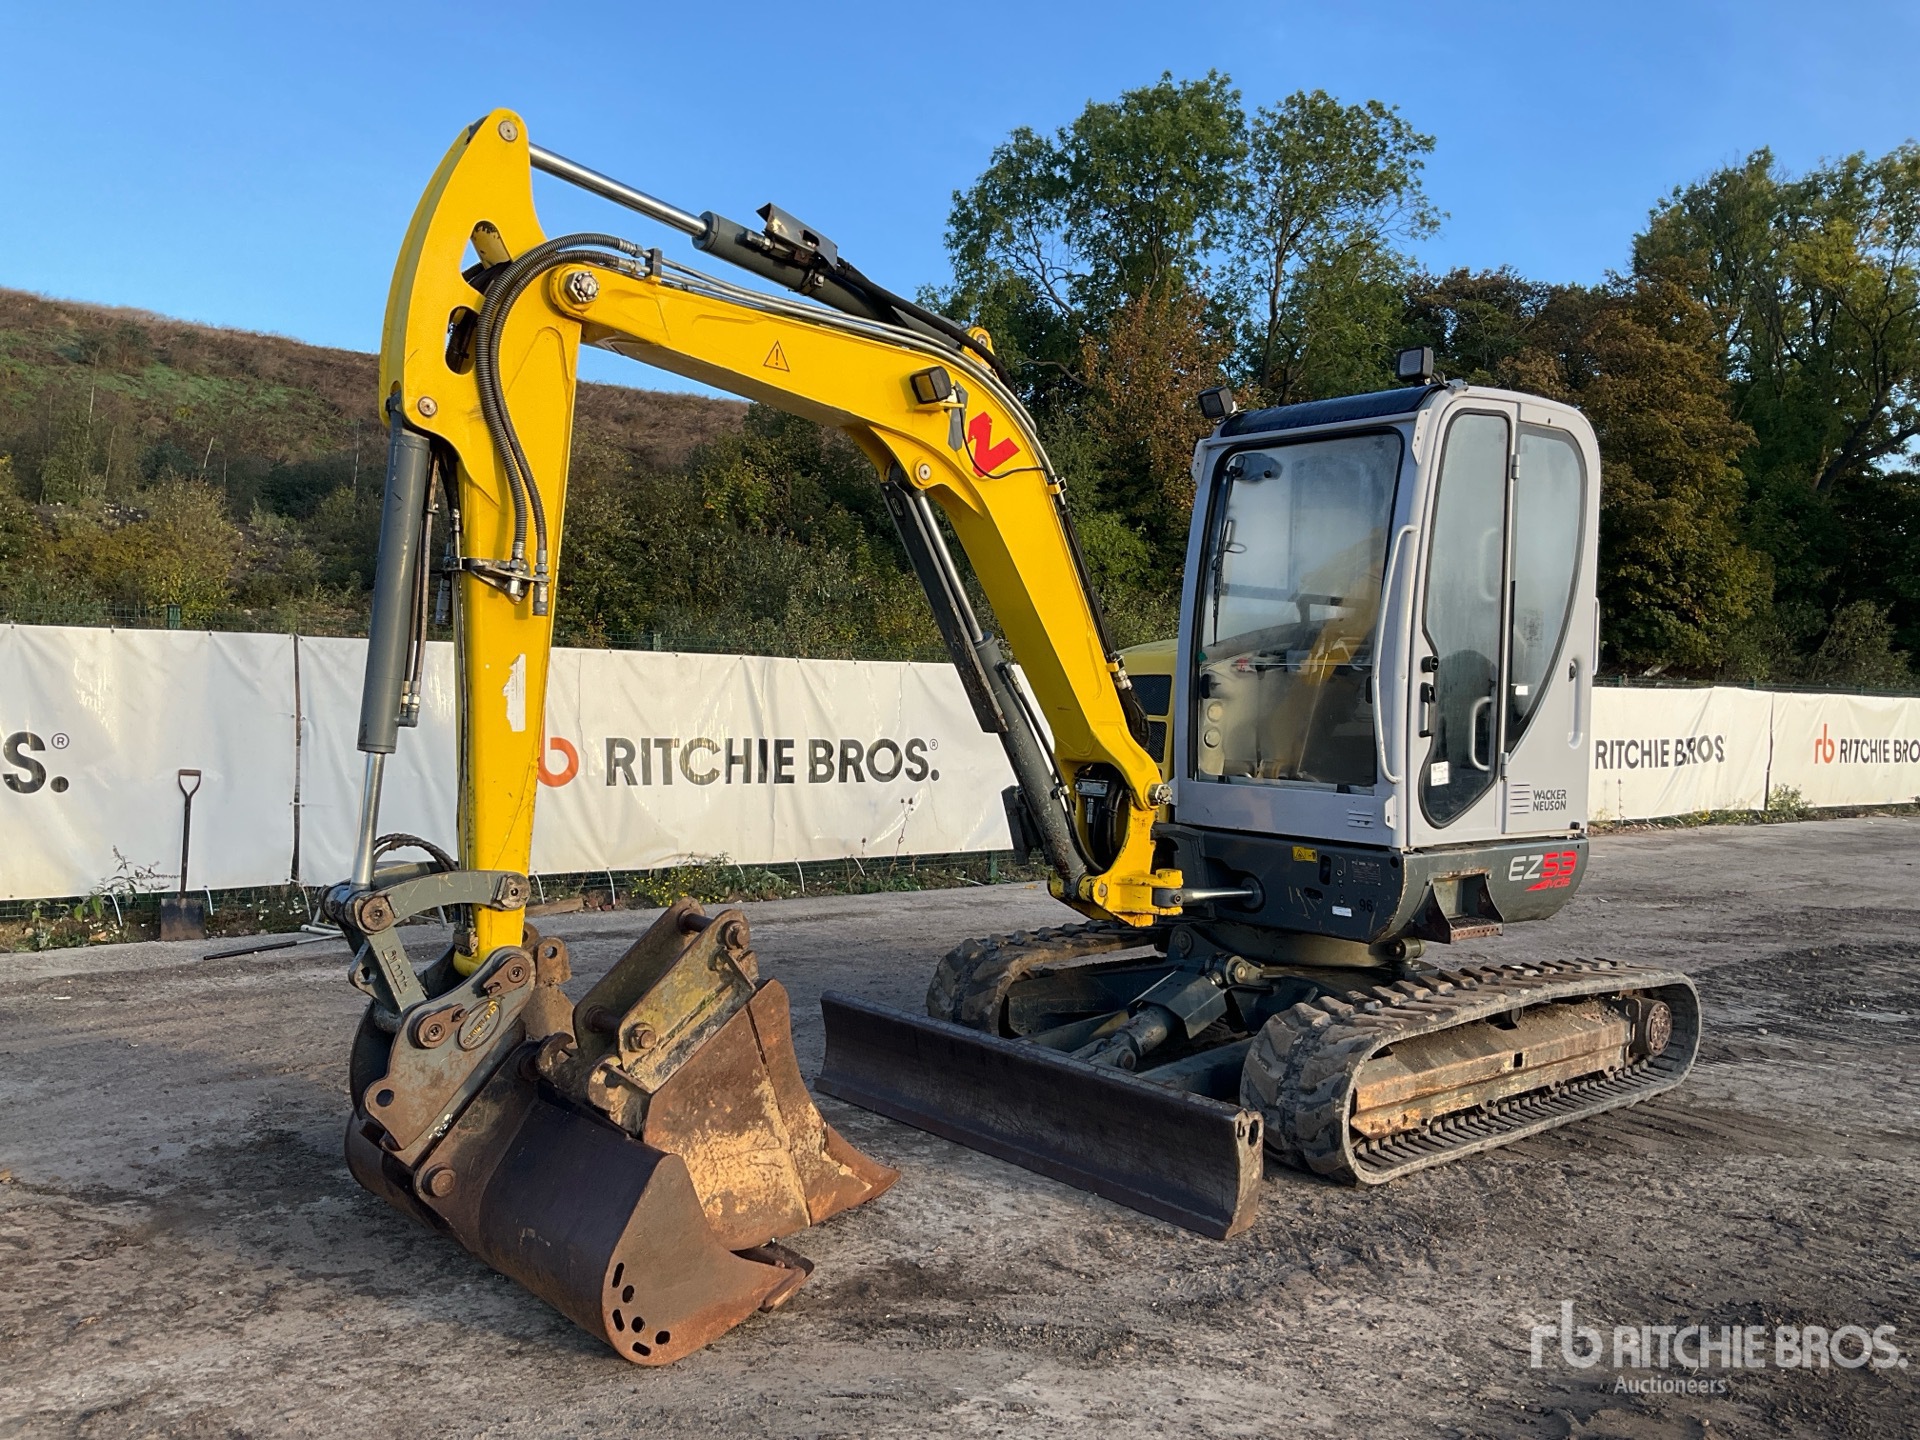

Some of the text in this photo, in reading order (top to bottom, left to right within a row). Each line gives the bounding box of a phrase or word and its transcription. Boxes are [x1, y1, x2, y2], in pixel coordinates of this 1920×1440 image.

[1595, 739, 1670, 769] RITCHIE
[1814, 723, 1835, 764] rb
[1839, 738, 1890, 764] RITCHIE
[605, 737, 795, 787] RITCHIE
[1532, 800, 1567, 811] NEUSON
[1533, 789, 1567, 801] WACKER
[1508, 850, 1577, 881] EZ53
[1359, 898, 1373, 913] 96
